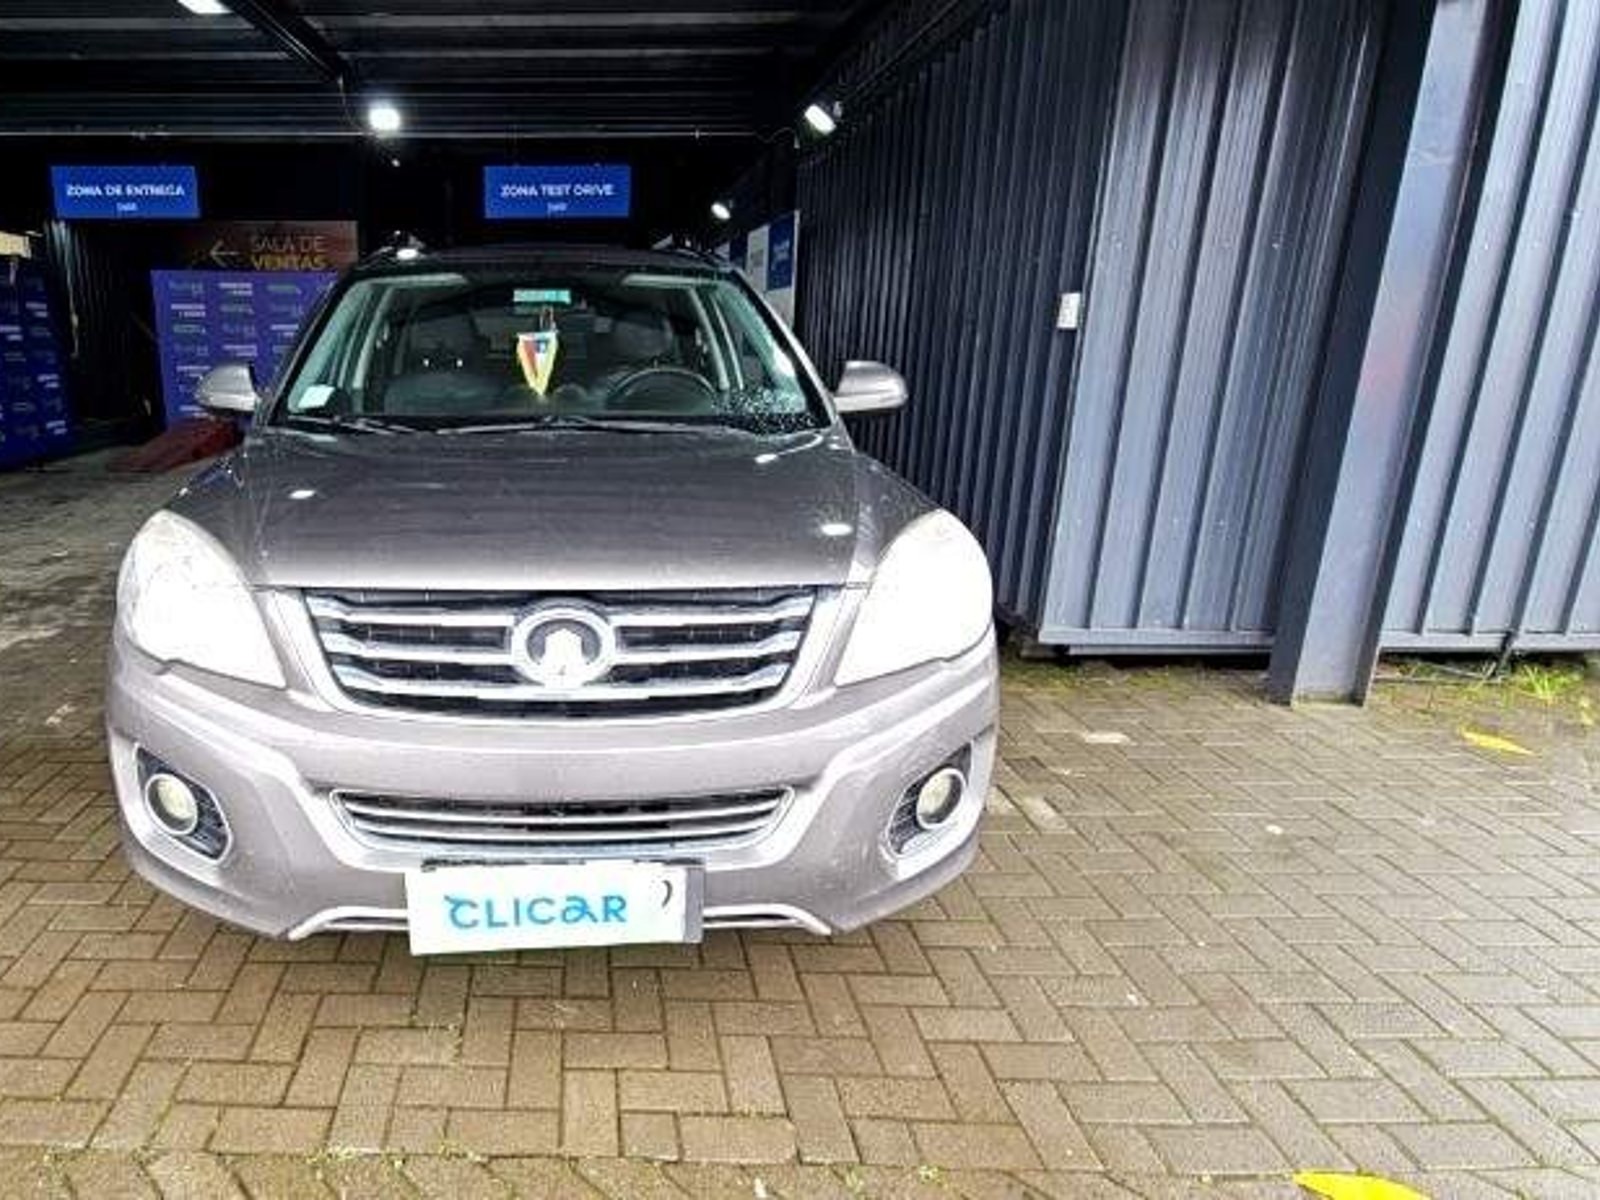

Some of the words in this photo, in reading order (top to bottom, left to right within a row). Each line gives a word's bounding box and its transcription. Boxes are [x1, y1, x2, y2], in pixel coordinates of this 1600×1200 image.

[66, 183, 102, 197] ZONA
[104, 183, 122, 196] DE
[125, 183, 185, 196] ENTREGA
[501, 184, 538, 197] ZONA
[540, 184, 571, 196] TEST
[573, 184, 614, 196] DRIVE
[300, 235, 327, 251] DE
[251, 253, 327, 270] VENTAS
